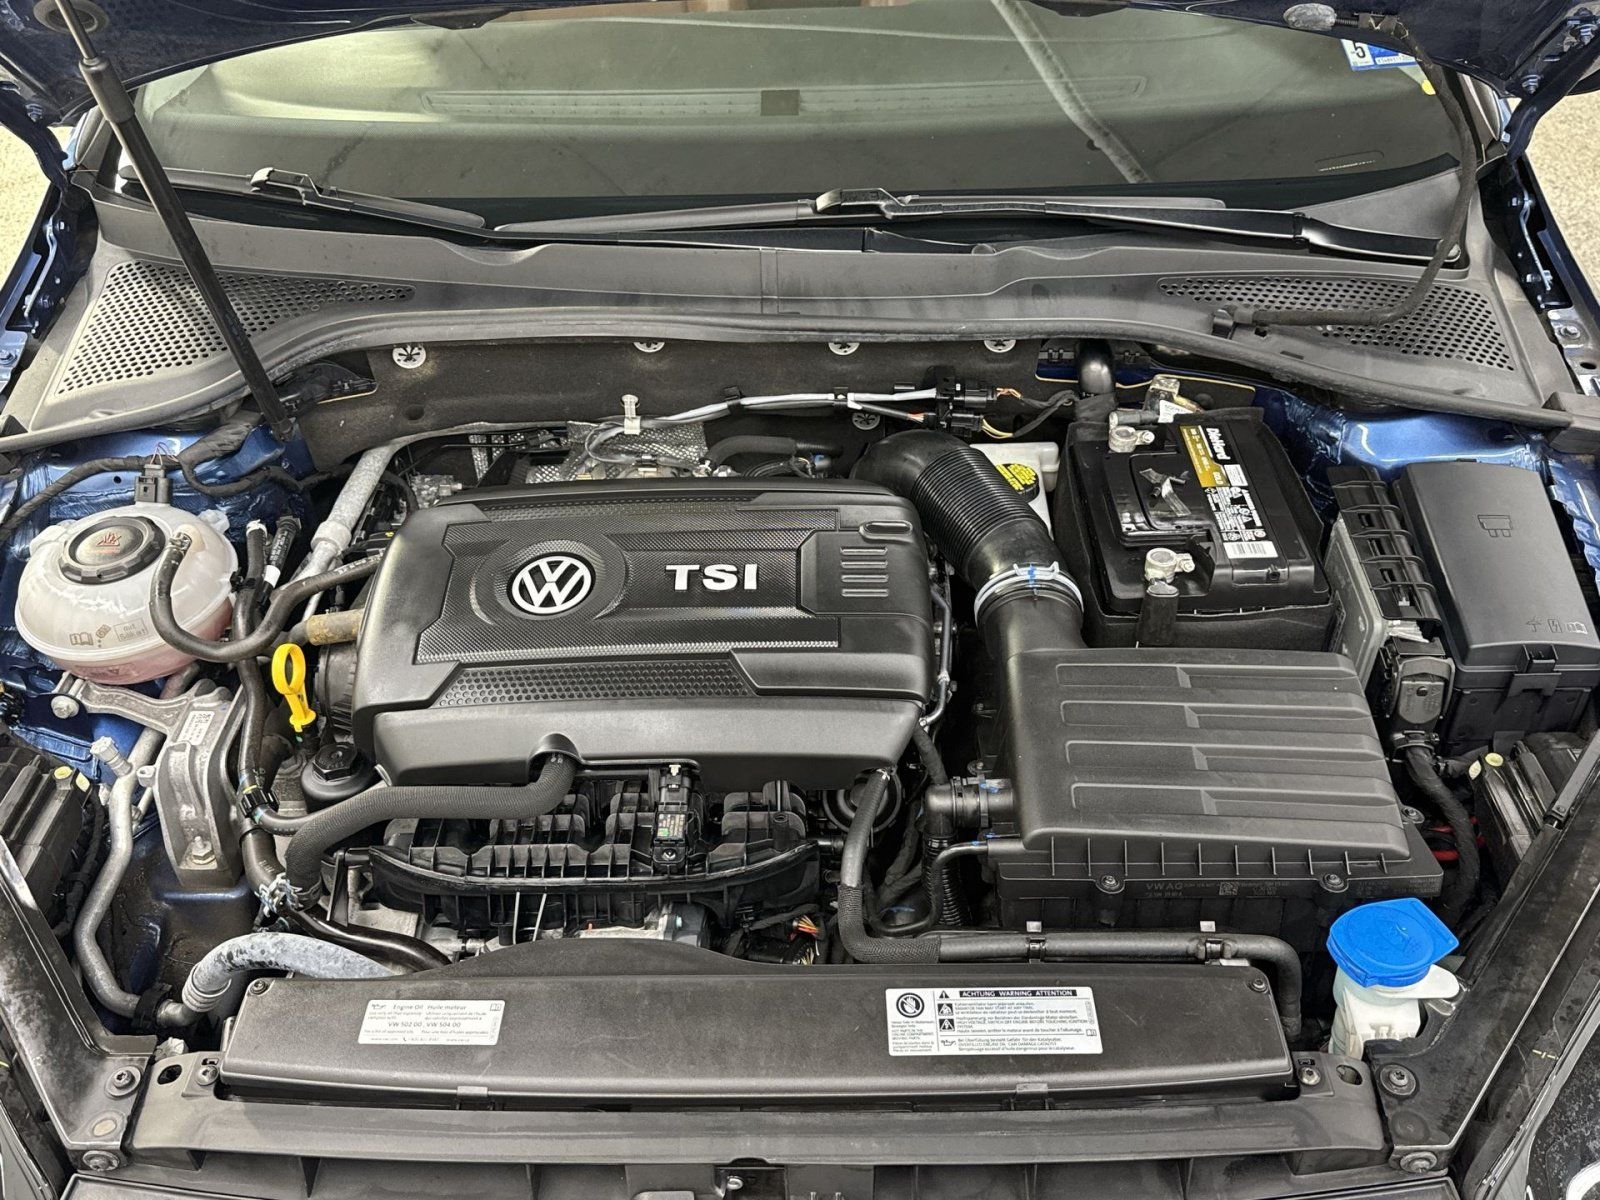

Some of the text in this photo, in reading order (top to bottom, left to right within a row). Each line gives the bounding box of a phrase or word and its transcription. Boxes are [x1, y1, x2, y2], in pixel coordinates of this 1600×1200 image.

[1353, 40, 1366, 58] 5
[1206, 428, 1231, 460] DieHard
[665, 563, 758, 591] TSI
